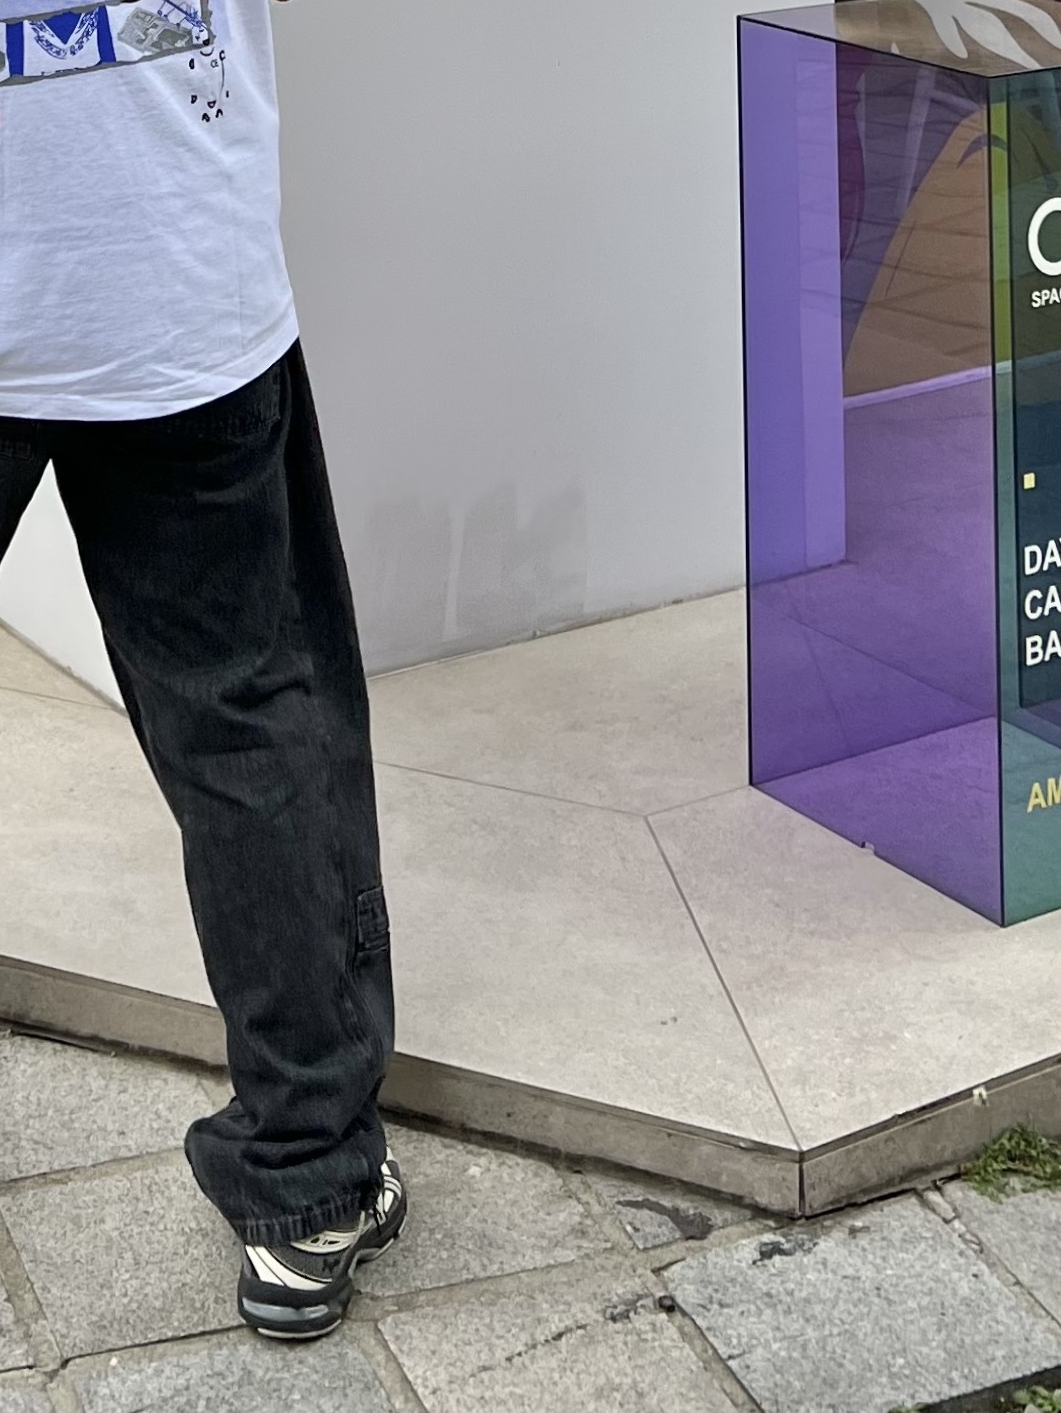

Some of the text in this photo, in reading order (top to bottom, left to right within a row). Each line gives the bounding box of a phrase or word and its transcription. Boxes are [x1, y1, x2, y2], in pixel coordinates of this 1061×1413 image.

[1030, 287, 1061, 308] SPA
[1023, 537, 1061, 576] DA
[1024, 585, 1061, 620] CA
[1025, 629, 1061, 667] BA
